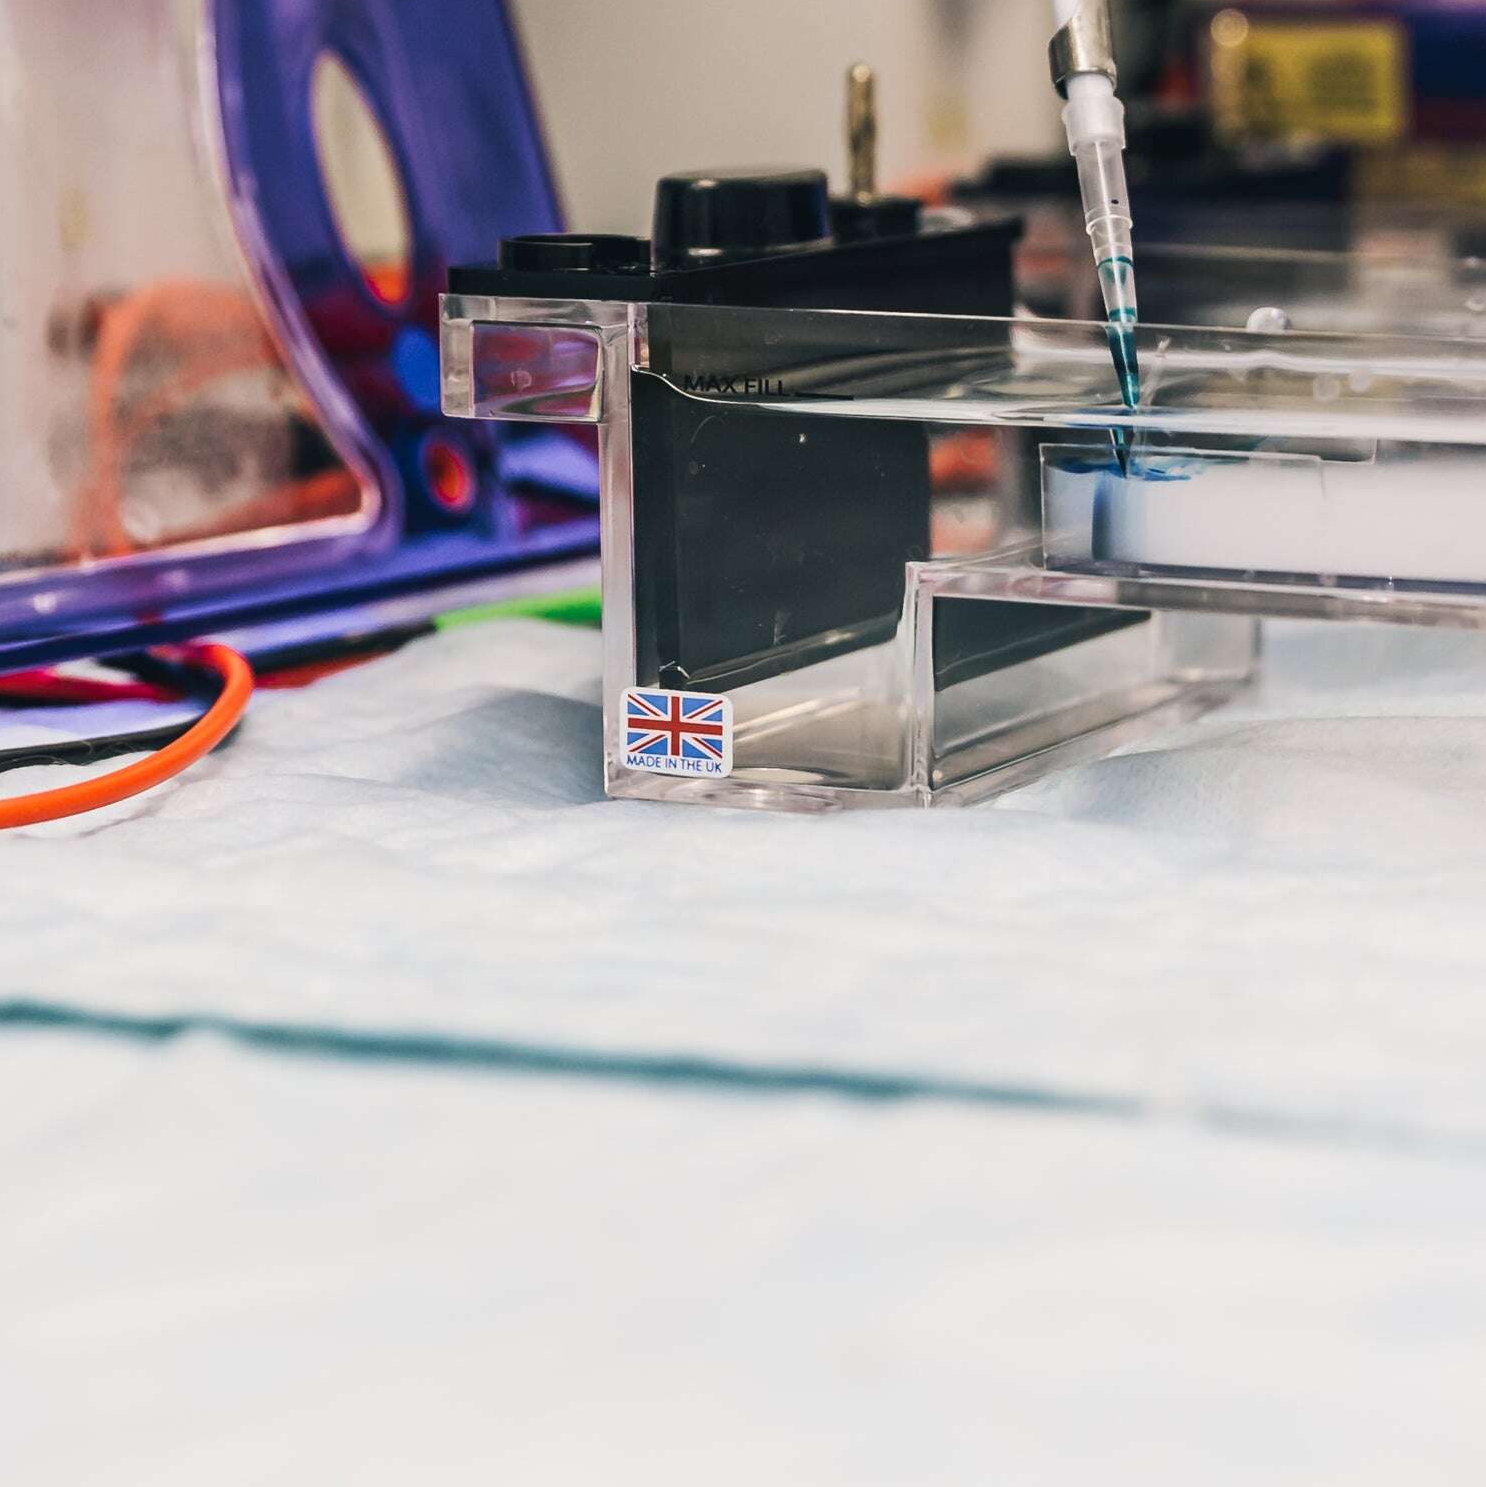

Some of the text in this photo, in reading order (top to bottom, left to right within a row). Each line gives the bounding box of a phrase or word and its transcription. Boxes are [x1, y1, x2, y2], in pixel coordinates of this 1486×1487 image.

[683, 374, 790, 397] MAX FILL
[626, 754, 722, 774] MADE IN THE UK
